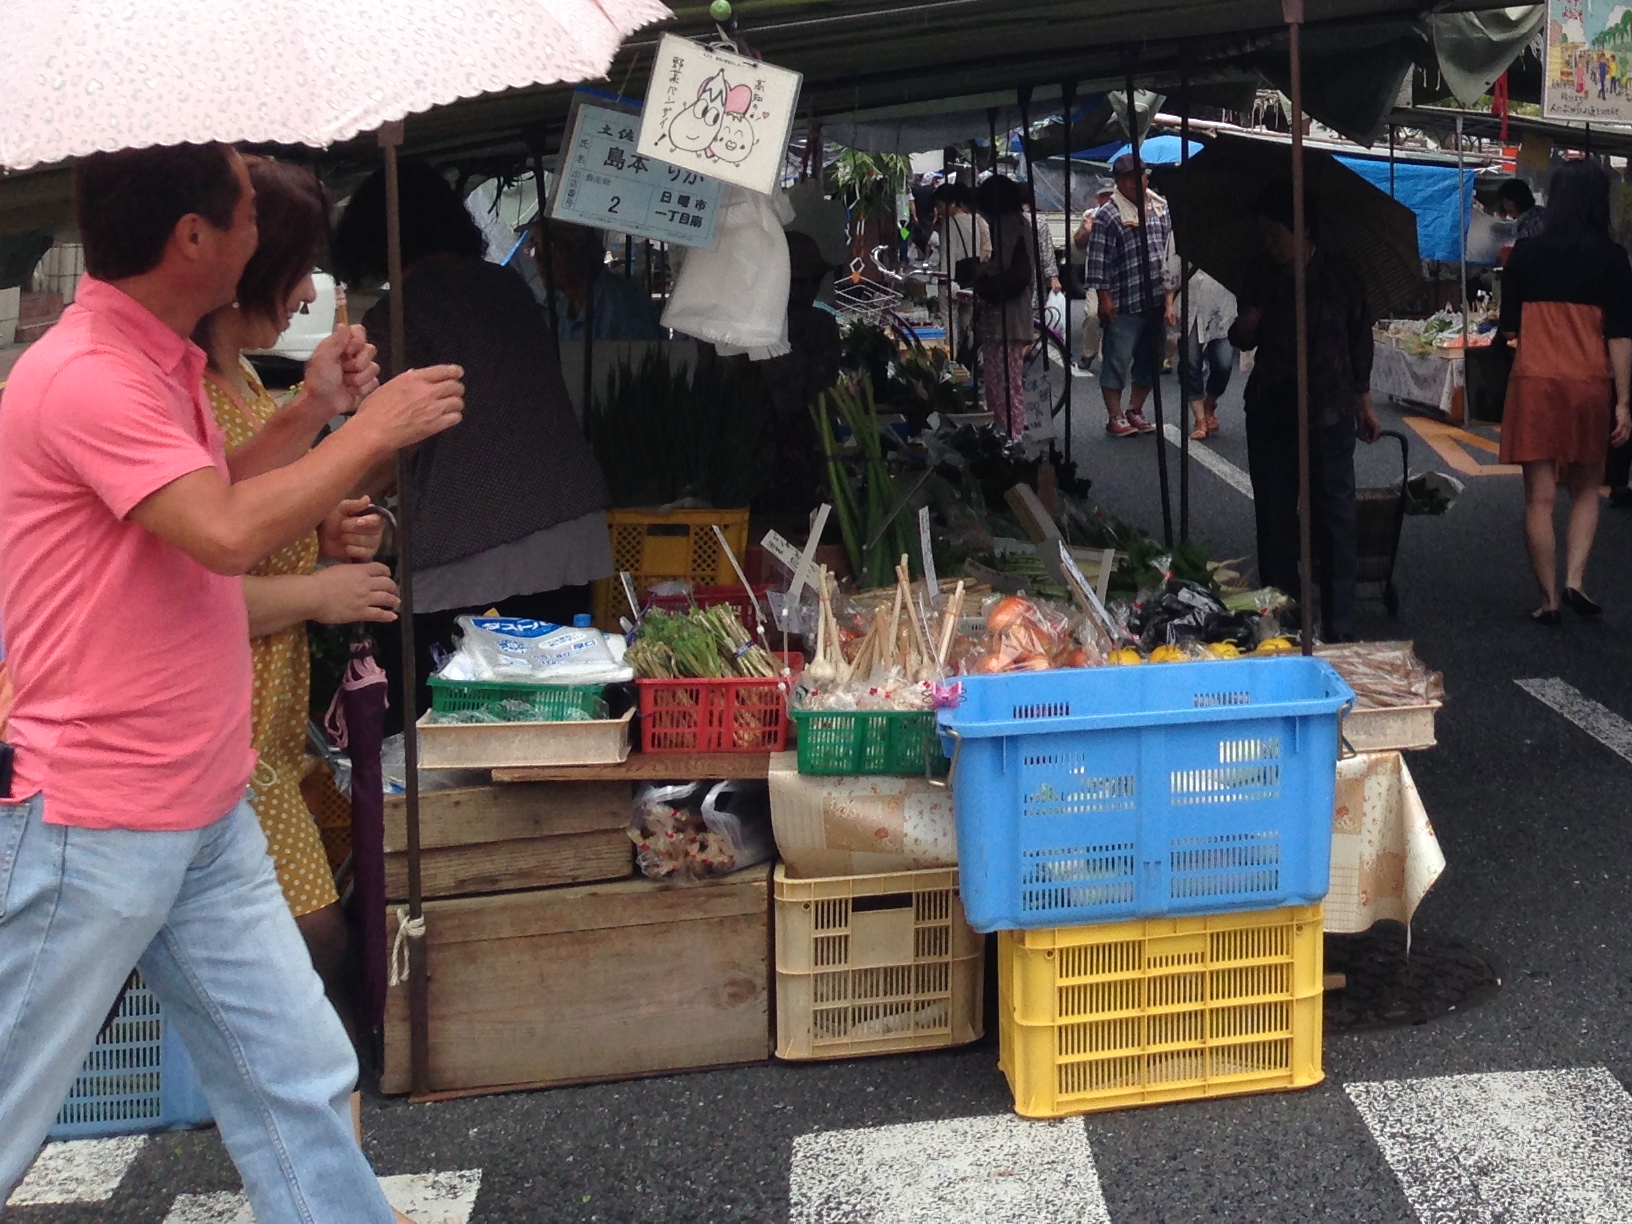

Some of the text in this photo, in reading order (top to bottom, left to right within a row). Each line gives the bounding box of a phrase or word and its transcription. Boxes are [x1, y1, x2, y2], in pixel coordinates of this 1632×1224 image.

[604, 147, 650, 174] 島本
[607, 196, 621, 214] 2
[660, 190, 708, 212] 日曜市
[654, 209, 704, 228] 一丁目南
